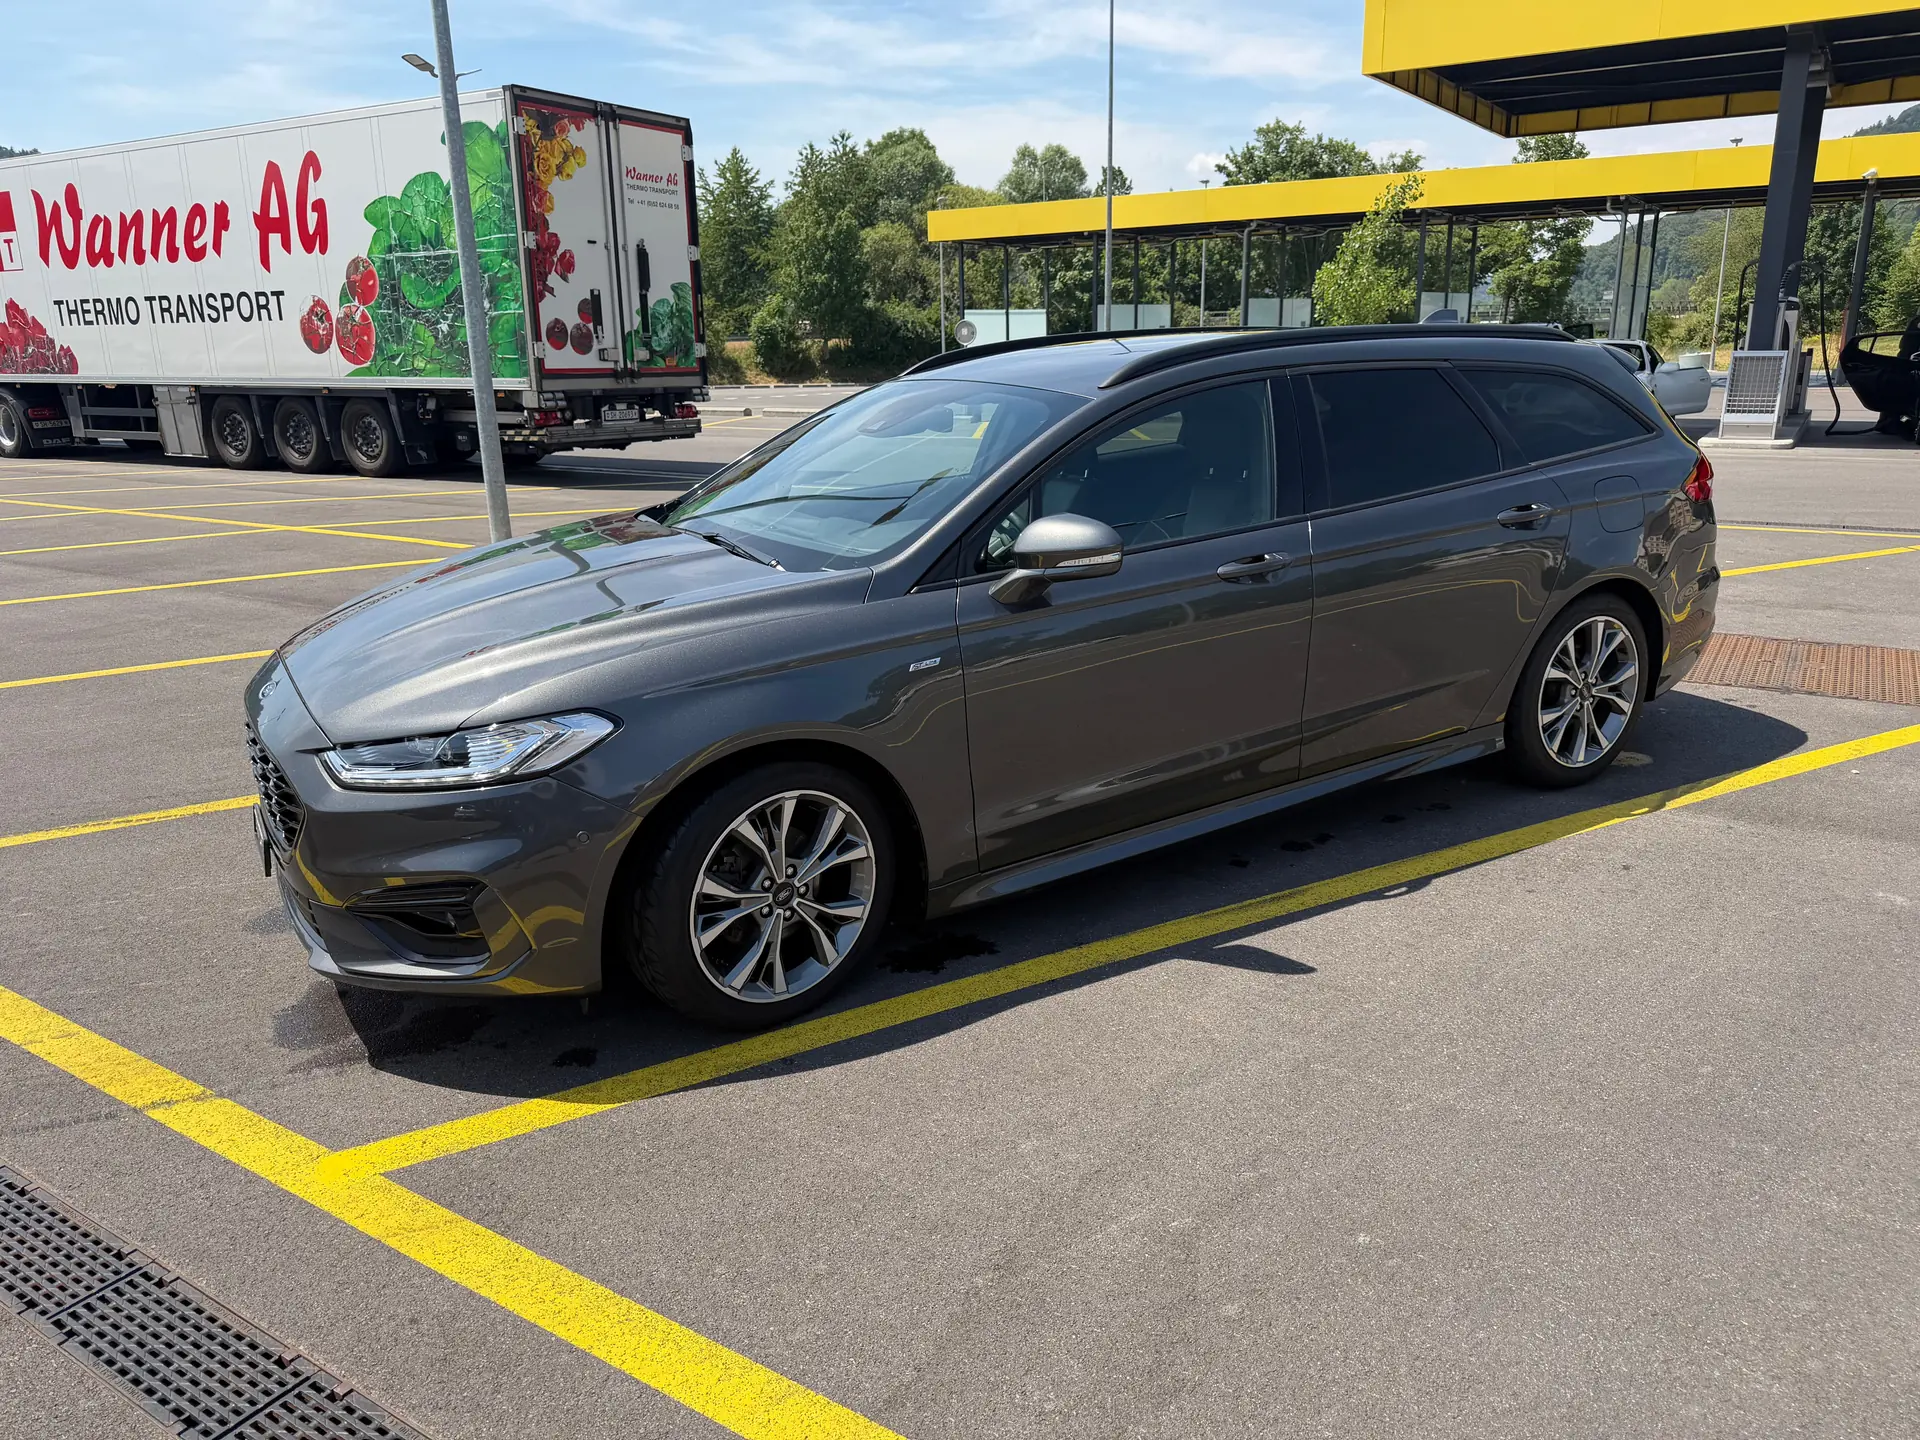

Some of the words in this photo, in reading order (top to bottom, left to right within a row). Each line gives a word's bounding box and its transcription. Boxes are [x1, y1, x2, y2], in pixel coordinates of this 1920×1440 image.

[625, 165, 663, 184] Wanner
[666, 172, 678, 187] AG
[626, 183, 649, 192] THERMO
[649, 186, 678, 196] TRANSPORT
[30, 182, 231, 270] Wanner
[252, 150, 330, 274] AG
[53, 298, 141, 327] THERMO
[144, 290, 286, 324] TRANSPORT
[43, 437, 71, 445] DAF
